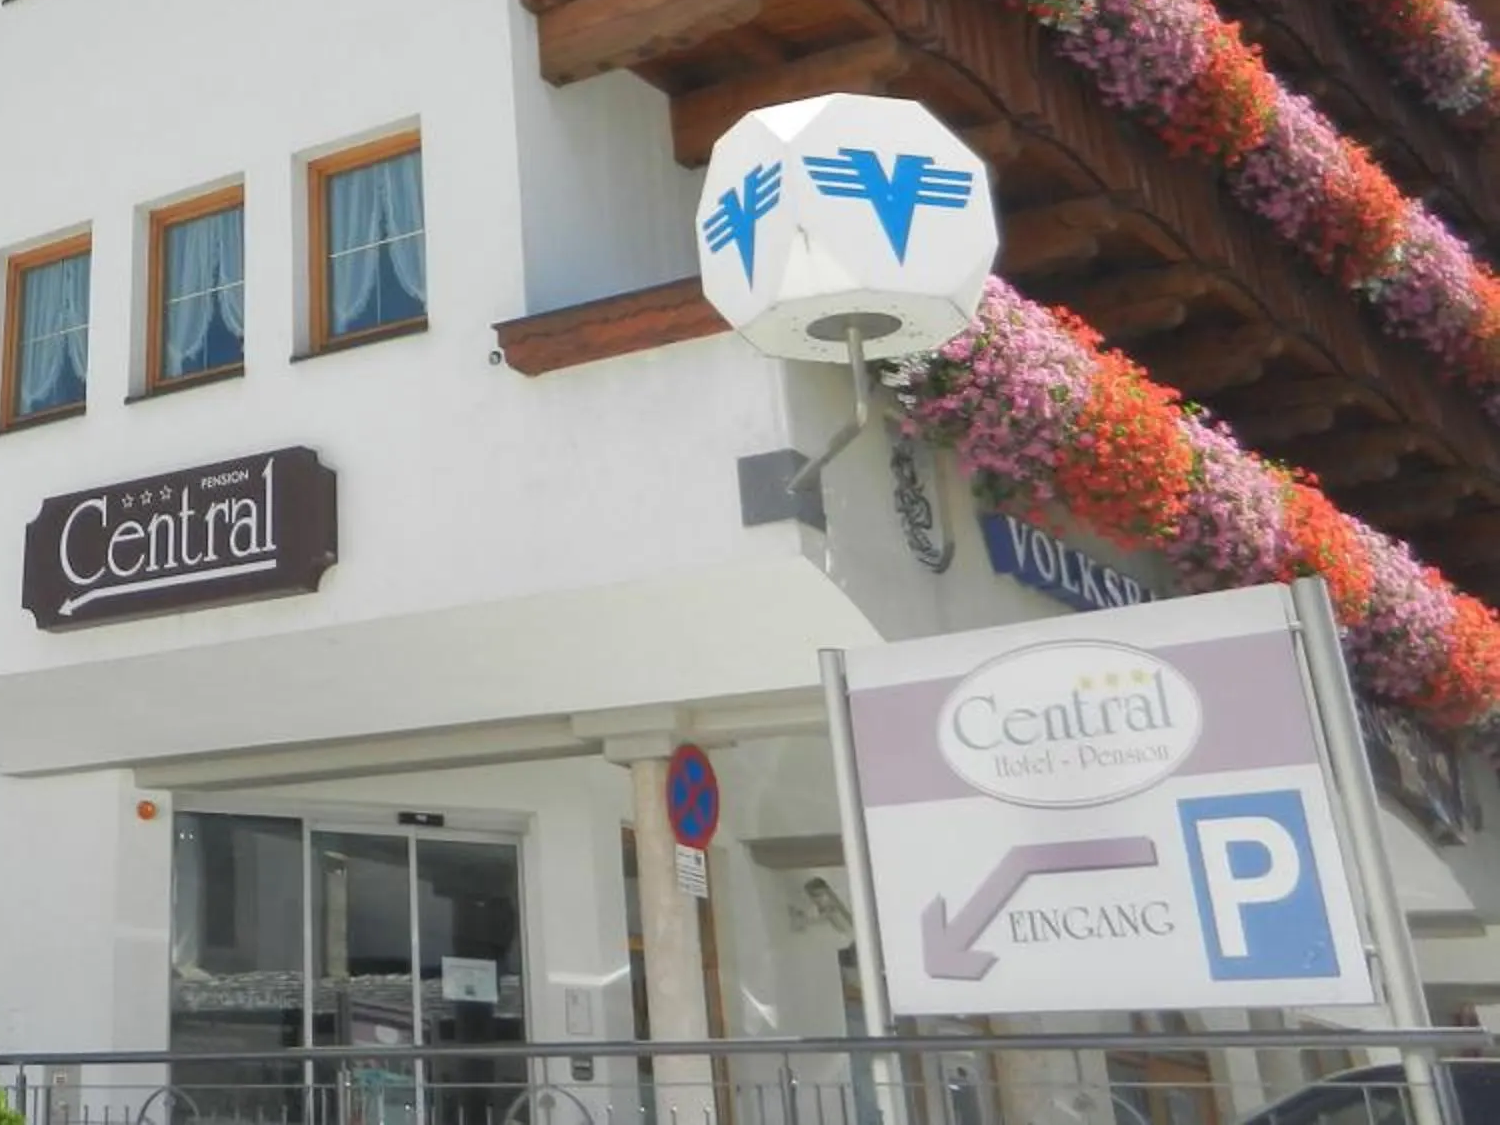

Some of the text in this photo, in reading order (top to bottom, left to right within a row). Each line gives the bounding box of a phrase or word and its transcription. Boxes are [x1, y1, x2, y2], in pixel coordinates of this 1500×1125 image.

[201, 468, 249, 490] PENSION
[59, 456, 277, 585] Central
[952, 667, 1175, 751] Central
[994, 749, 1056, 777] Hotel
[1078, 743, 1170, 771] Pension
[1196, 815, 1301, 958] P
[1007, 900, 1176, 944] EINGANG
